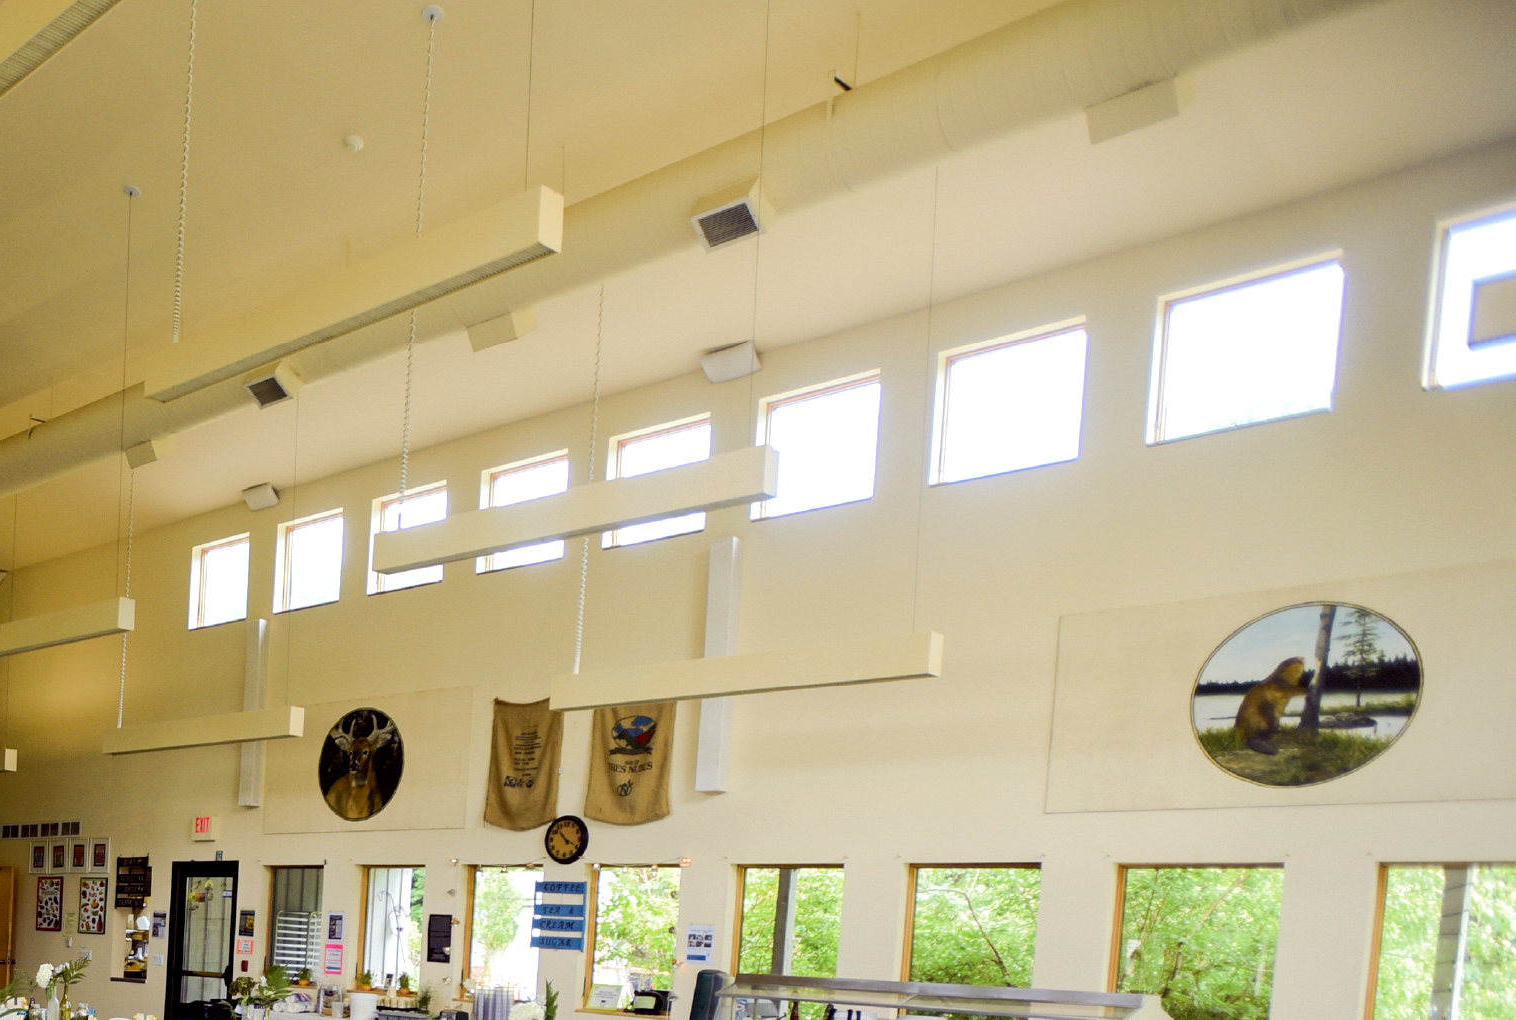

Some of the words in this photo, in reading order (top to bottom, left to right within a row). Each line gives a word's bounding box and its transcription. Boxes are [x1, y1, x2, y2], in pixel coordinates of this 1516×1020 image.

[195, 816, 210, 833] EXIT
[543, 883, 581, 892] COFFEE
[542, 906, 561, 915] TEA
[539, 920, 575, 930] CREAM
[539, 937, 572, 948] SUGAR
